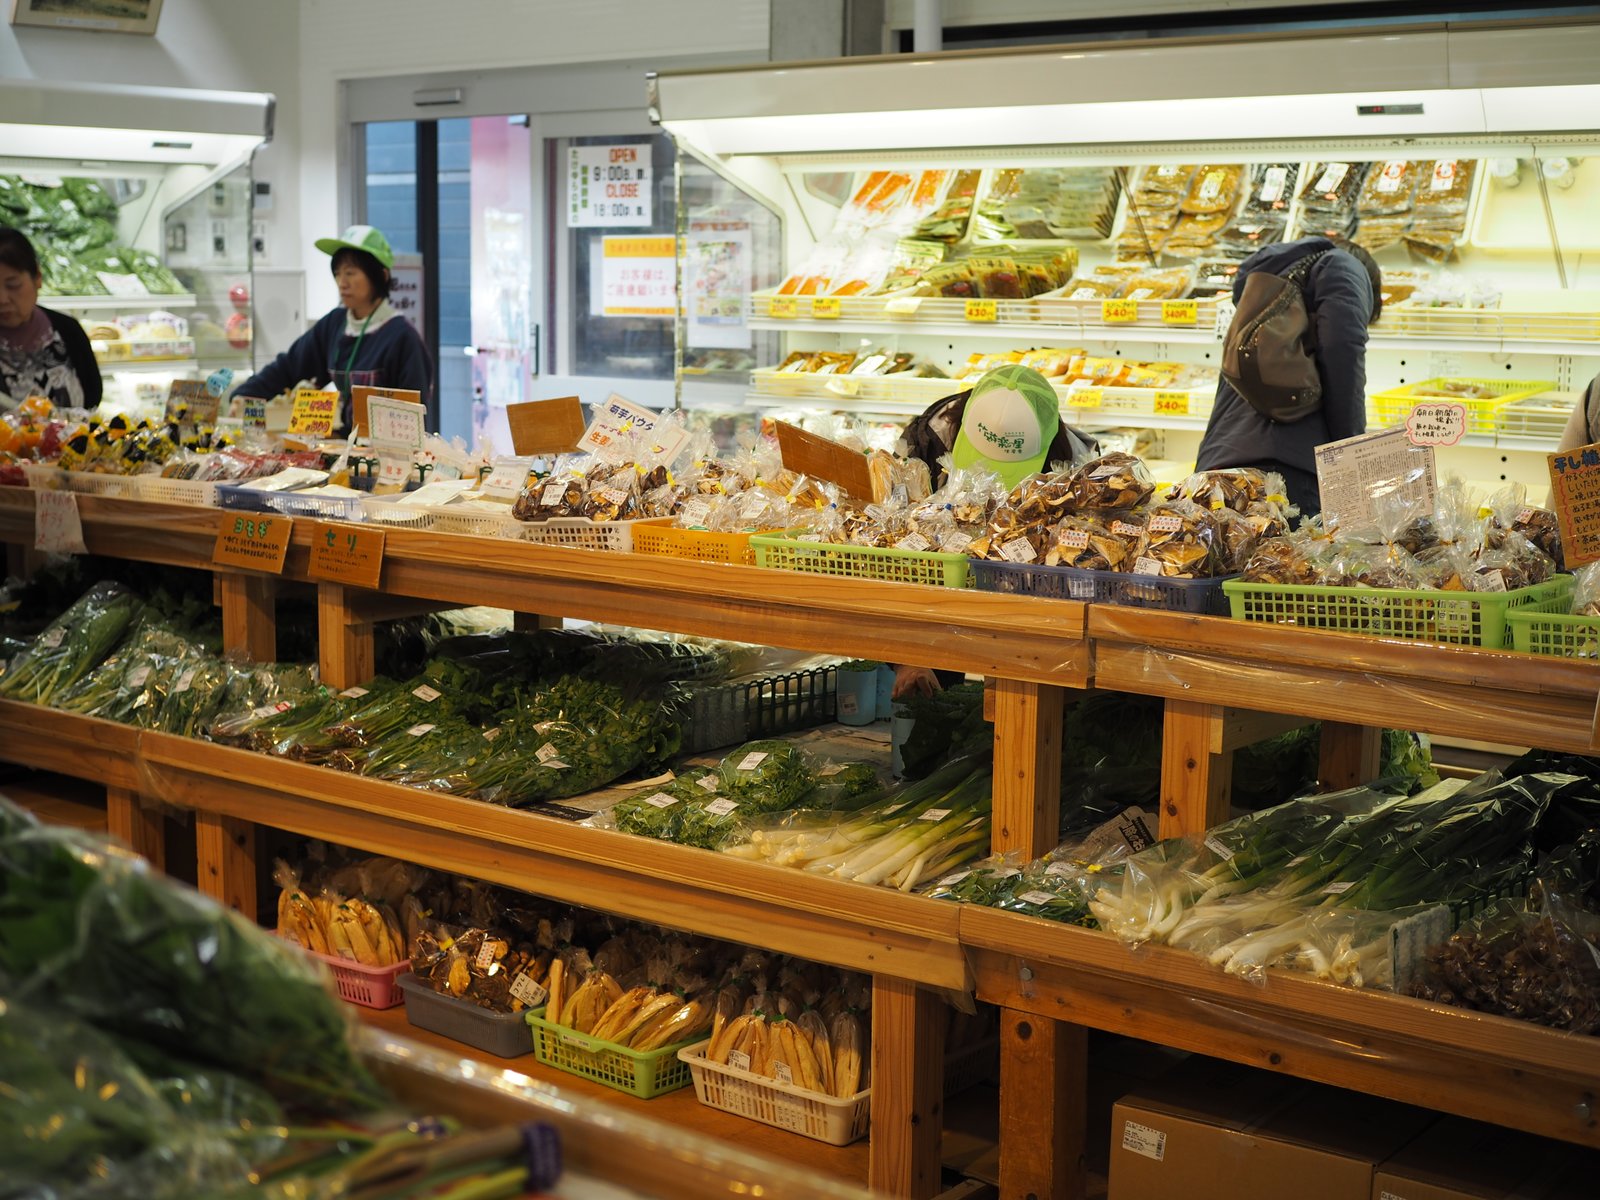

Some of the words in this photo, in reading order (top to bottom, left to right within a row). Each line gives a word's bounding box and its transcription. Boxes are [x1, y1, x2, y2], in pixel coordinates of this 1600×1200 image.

[608, 148, 638, 163] OPEN
[606, 183, 640, 198] CLOSE
[325, 528, 357, 552] セリ
